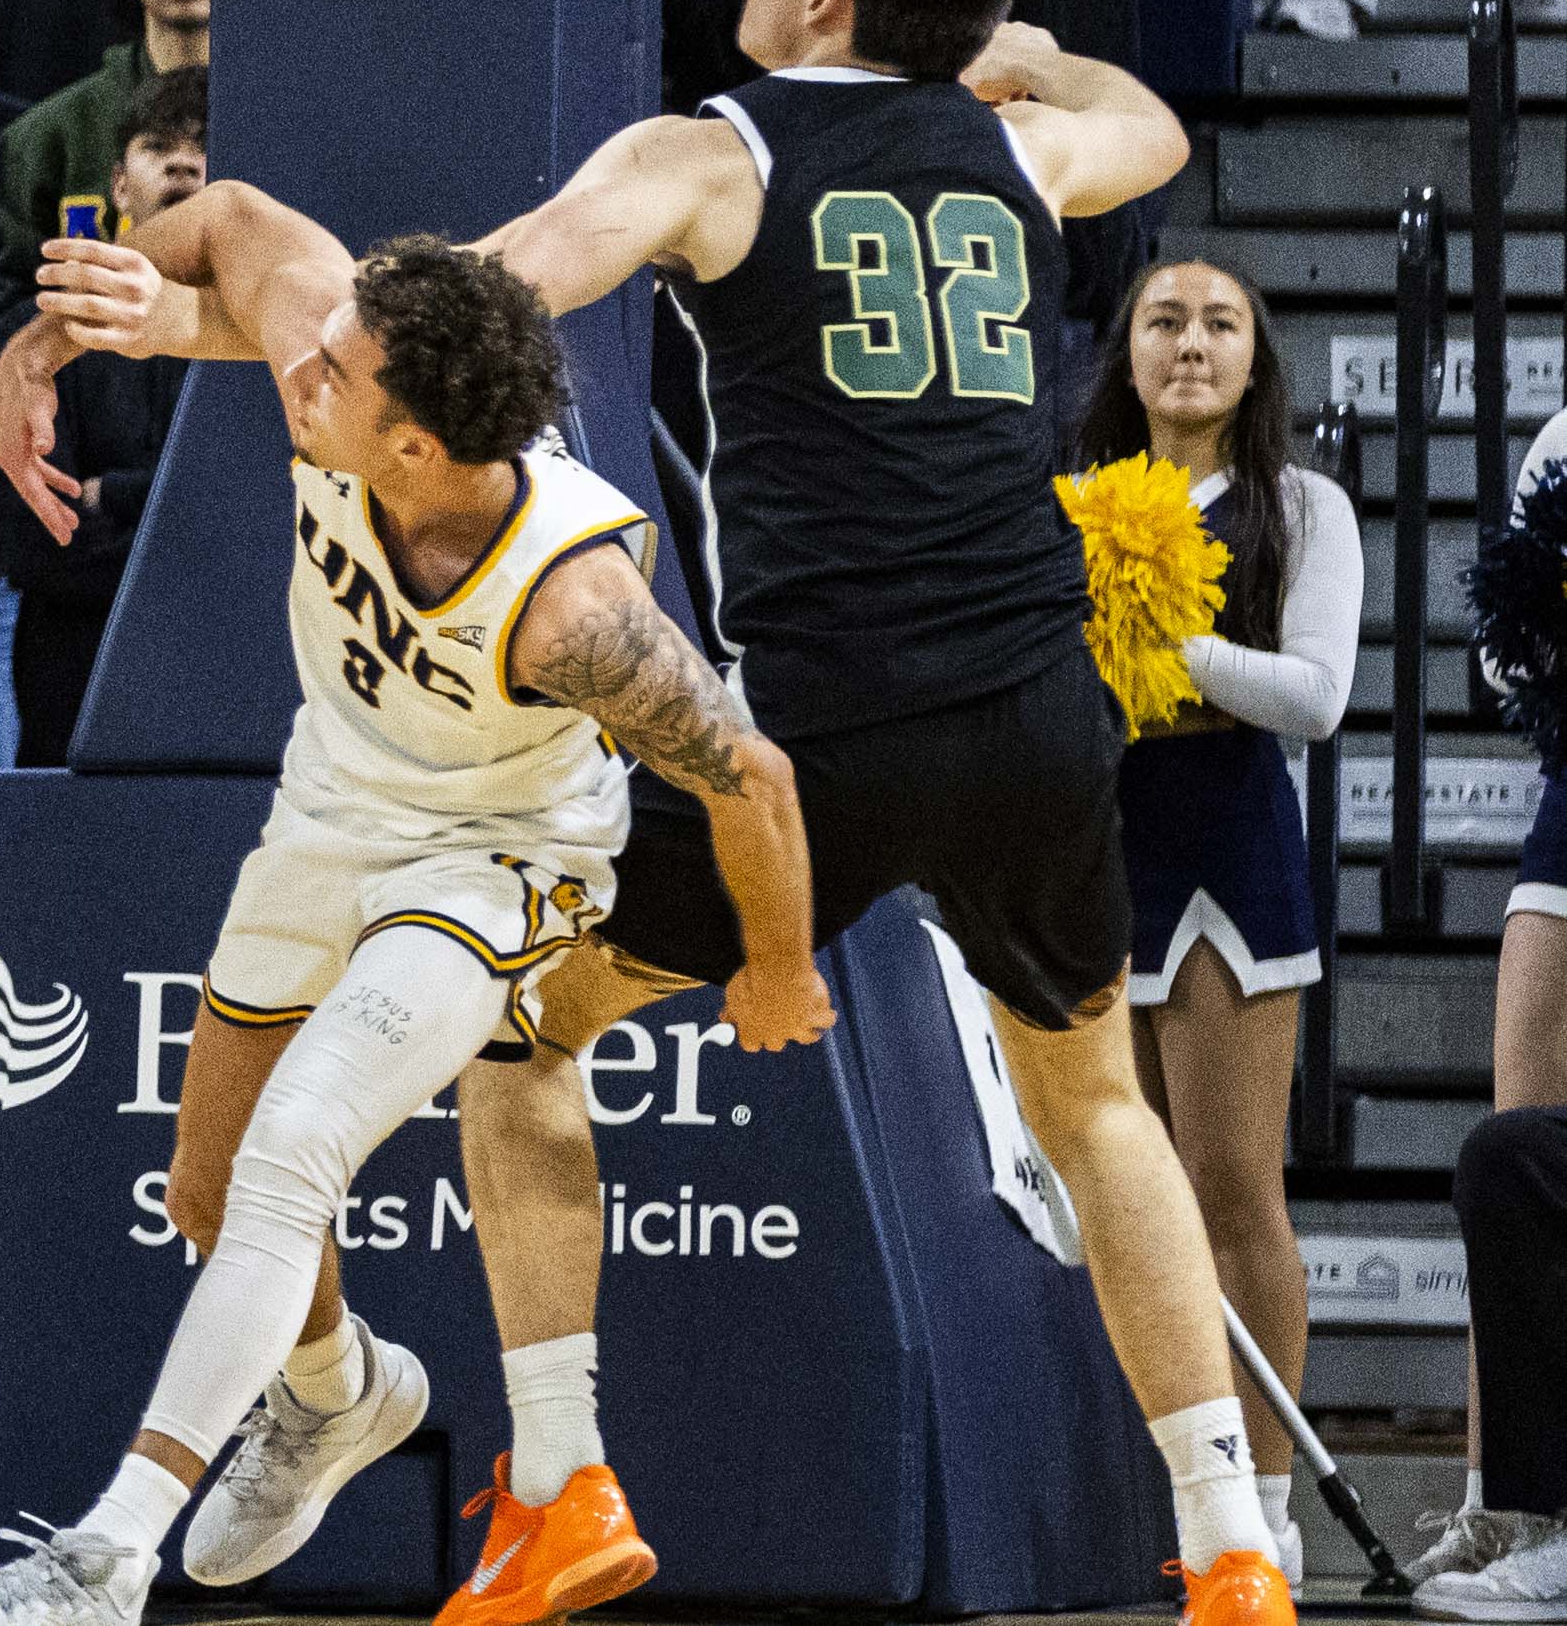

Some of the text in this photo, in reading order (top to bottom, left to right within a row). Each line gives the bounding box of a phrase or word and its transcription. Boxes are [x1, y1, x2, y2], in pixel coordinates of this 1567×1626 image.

[810, 190, 1035, 406] 32
[298, 502, 475, 712] UNC
[347, 985, 413, 1022] JESUS
[354, 1007, 408, 1045] KING
[430, 1177, 800, 1258] Micine
